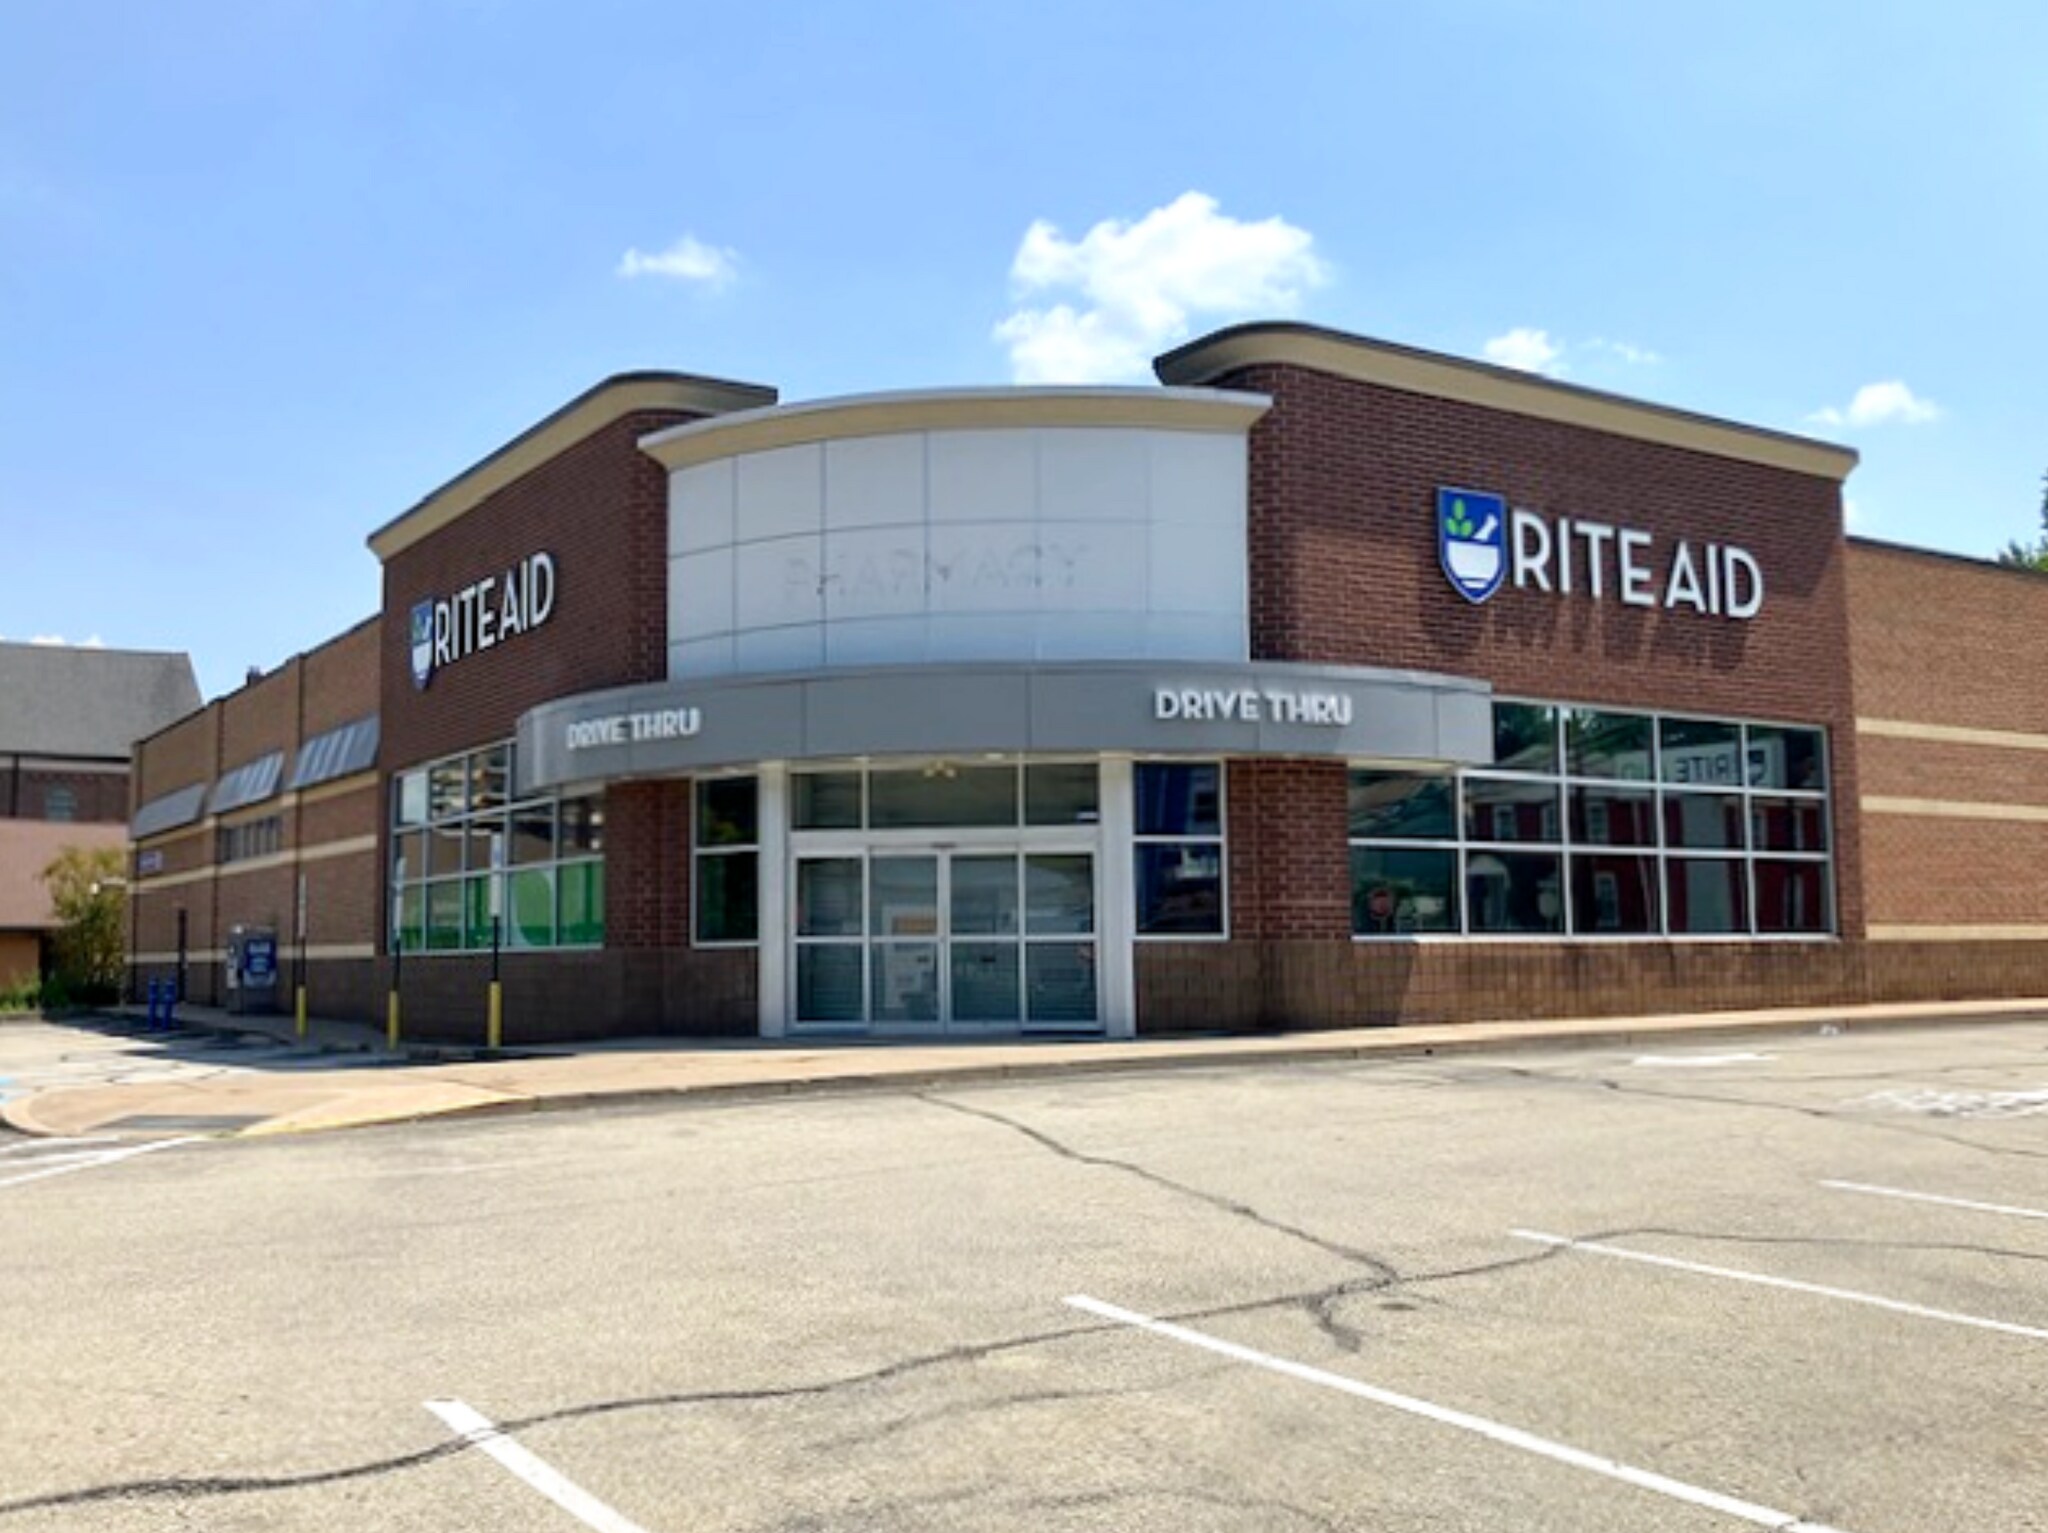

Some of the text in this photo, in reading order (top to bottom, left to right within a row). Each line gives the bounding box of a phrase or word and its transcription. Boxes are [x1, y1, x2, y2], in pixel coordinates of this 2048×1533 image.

[1512, 508, 1763, 619] RITE AID
[435, 551, 555, 667] RITE AID
[566, 707, 700, 749] DRIVE THRU
[1155, 691, 1352, 725] DRIVE THRU
